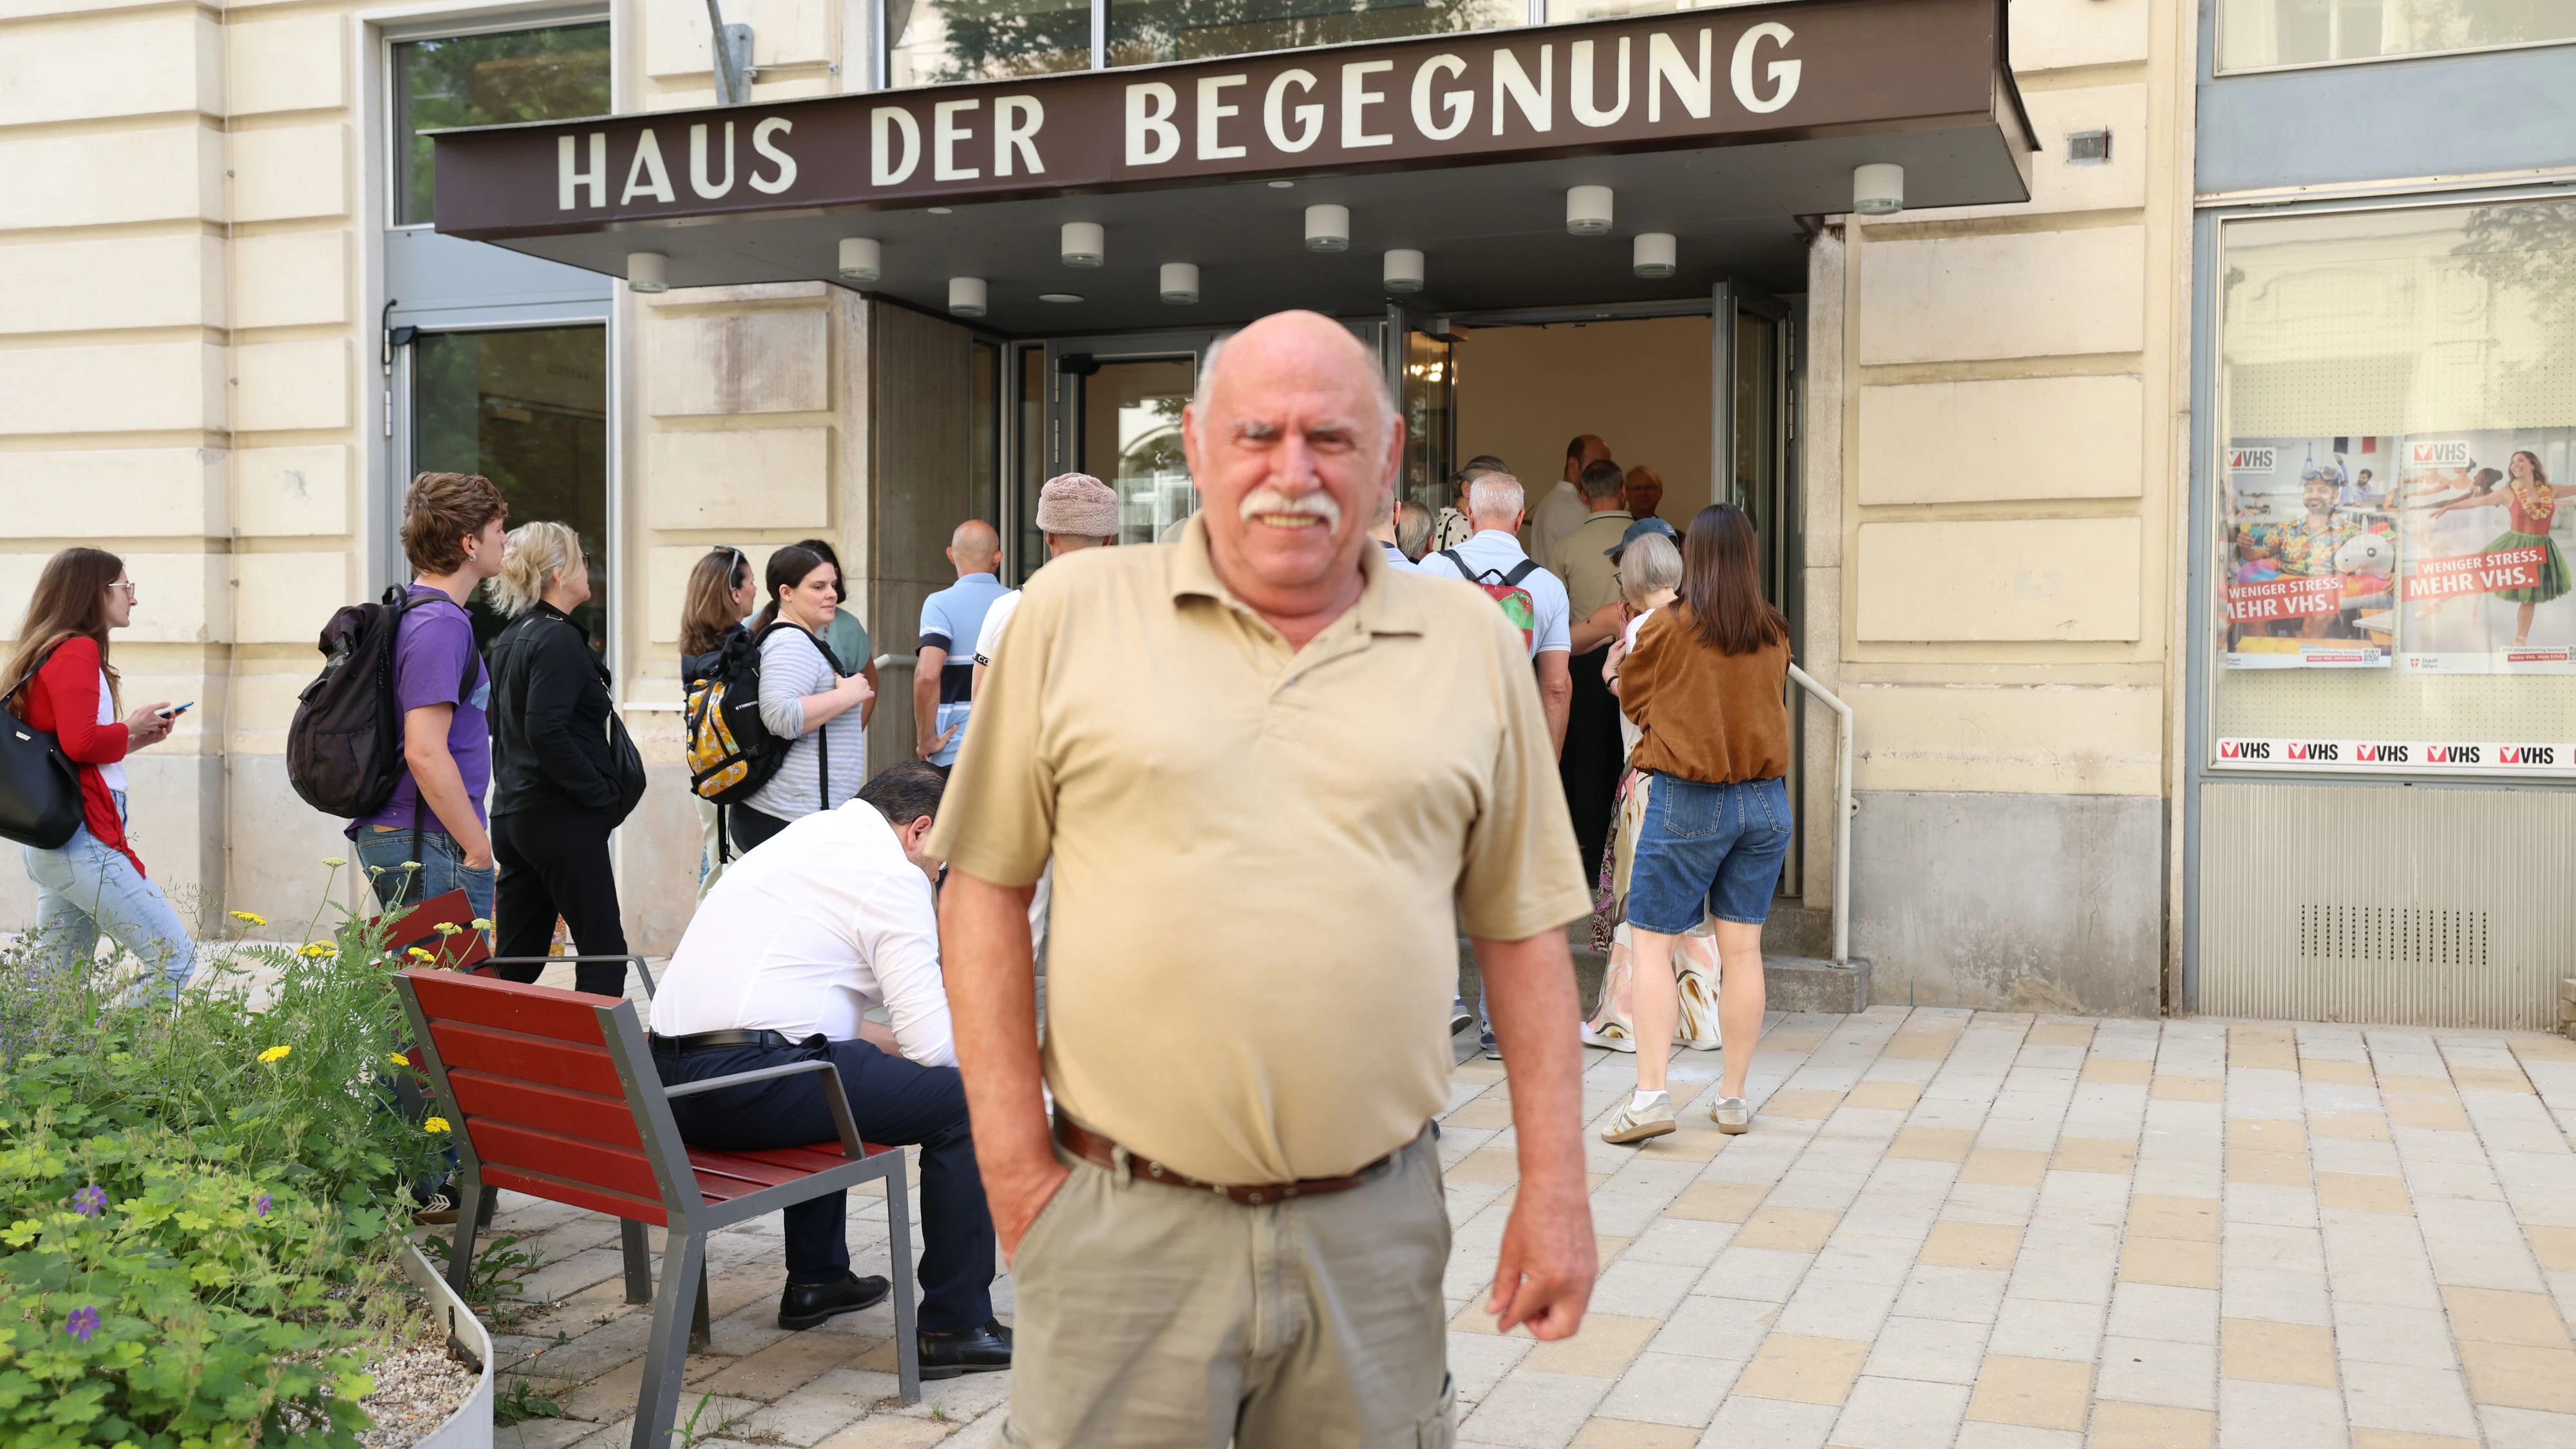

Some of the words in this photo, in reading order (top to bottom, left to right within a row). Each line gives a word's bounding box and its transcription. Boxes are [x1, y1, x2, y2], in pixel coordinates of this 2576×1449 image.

[559, 118, 797, 210] HAUS
[871, 95, 1045, 186] DER
[1125, 22, 1802, 166] BEGEGNUNG
[2242, 450, 2273, 467] VHS
[2434, 443, 2466, 460] VHS
[2422, 558, 2482, 574] WENIGER
[2486, 549, 2543, 567] STRESS.
[2229, 583, 2286, 599] WENIGER
[2289, 577, 2344, 593] STRESS.
[2410, 573, 2474, 597] MEHR
[2479, 567, 2534, 588] VHS.
[2283, 594, 2334, 614] VHS.
[2240, 742, 2270, 759] VHS
[2307, 744, 2338, 761] VHS
[2376, 745, 2409, 762] VHS
[2447, 746, 2480, 763] VHS
[2520, 747, 2554, 764] VHS
